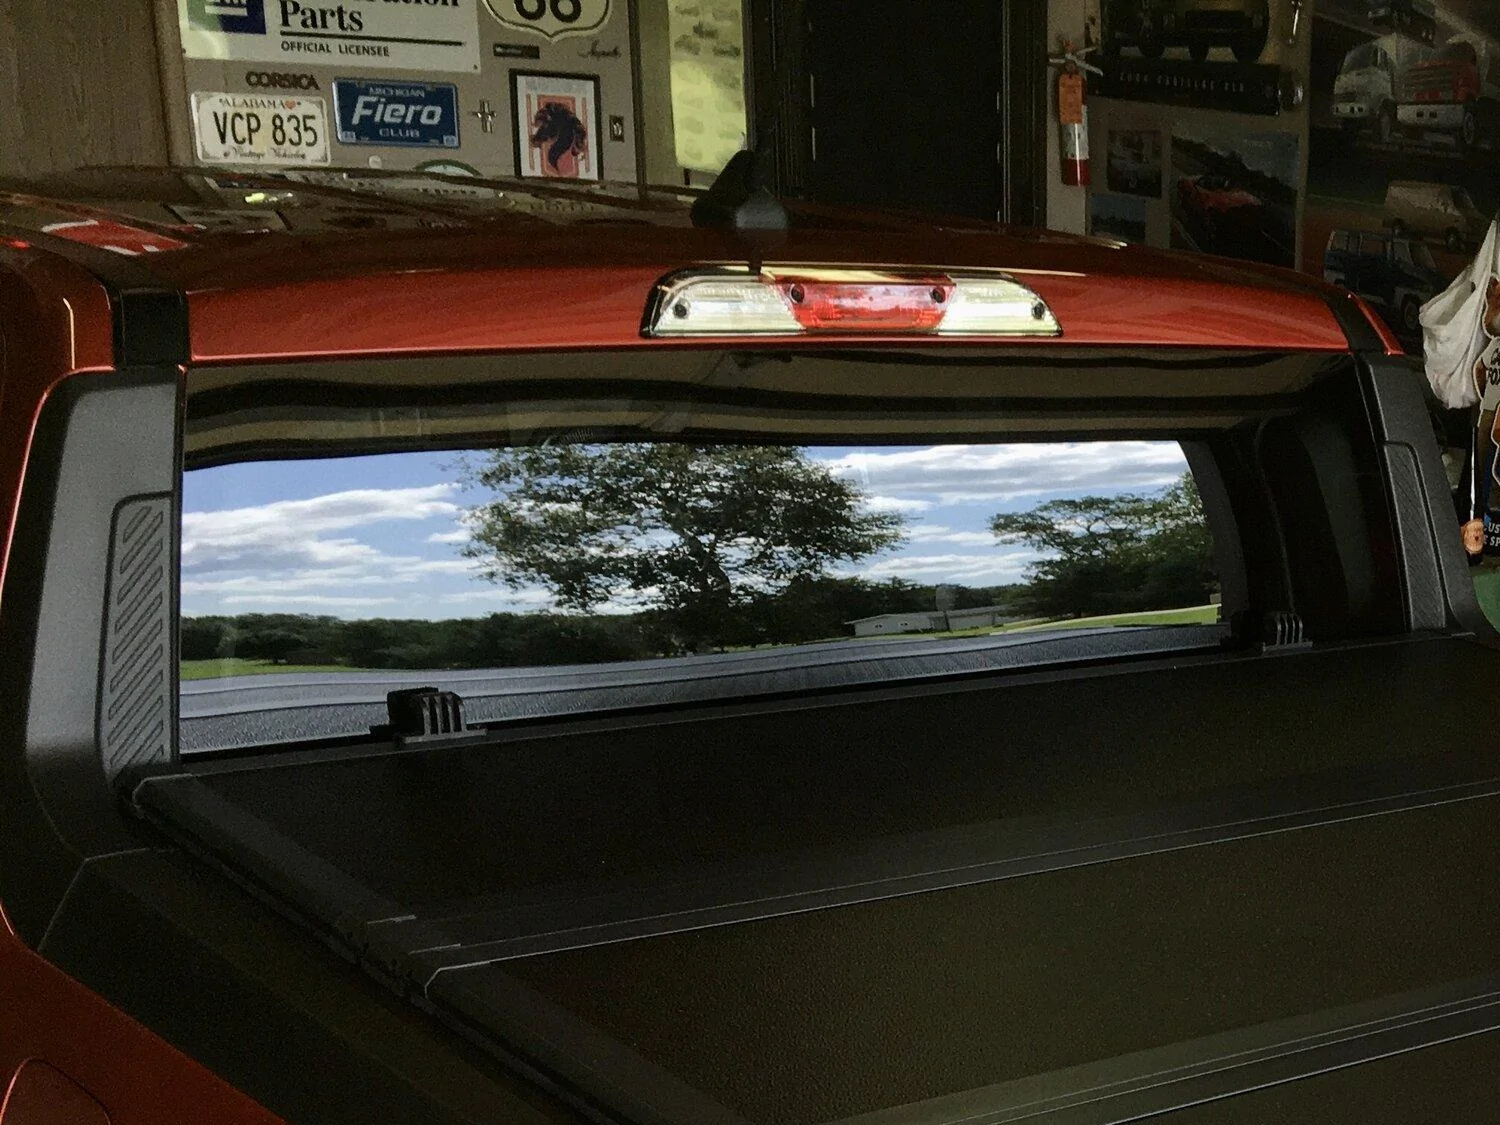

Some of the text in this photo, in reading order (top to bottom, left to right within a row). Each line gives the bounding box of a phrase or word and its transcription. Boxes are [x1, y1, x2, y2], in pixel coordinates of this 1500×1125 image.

[280, 0, 363, 32] Parts
[280, 40, 390, 57] OFFICIAL LICENSEE
[245, 71, 320, 91] CORSICA
[368, 86, 425, 98] MICHIGAN
[224, 97, 286, 110] ALABAMA
[351, 95, 442, 126] Fiero
[213, 110, 318, 147] VCP 835
[379, 129, 420, 138] CLUB
